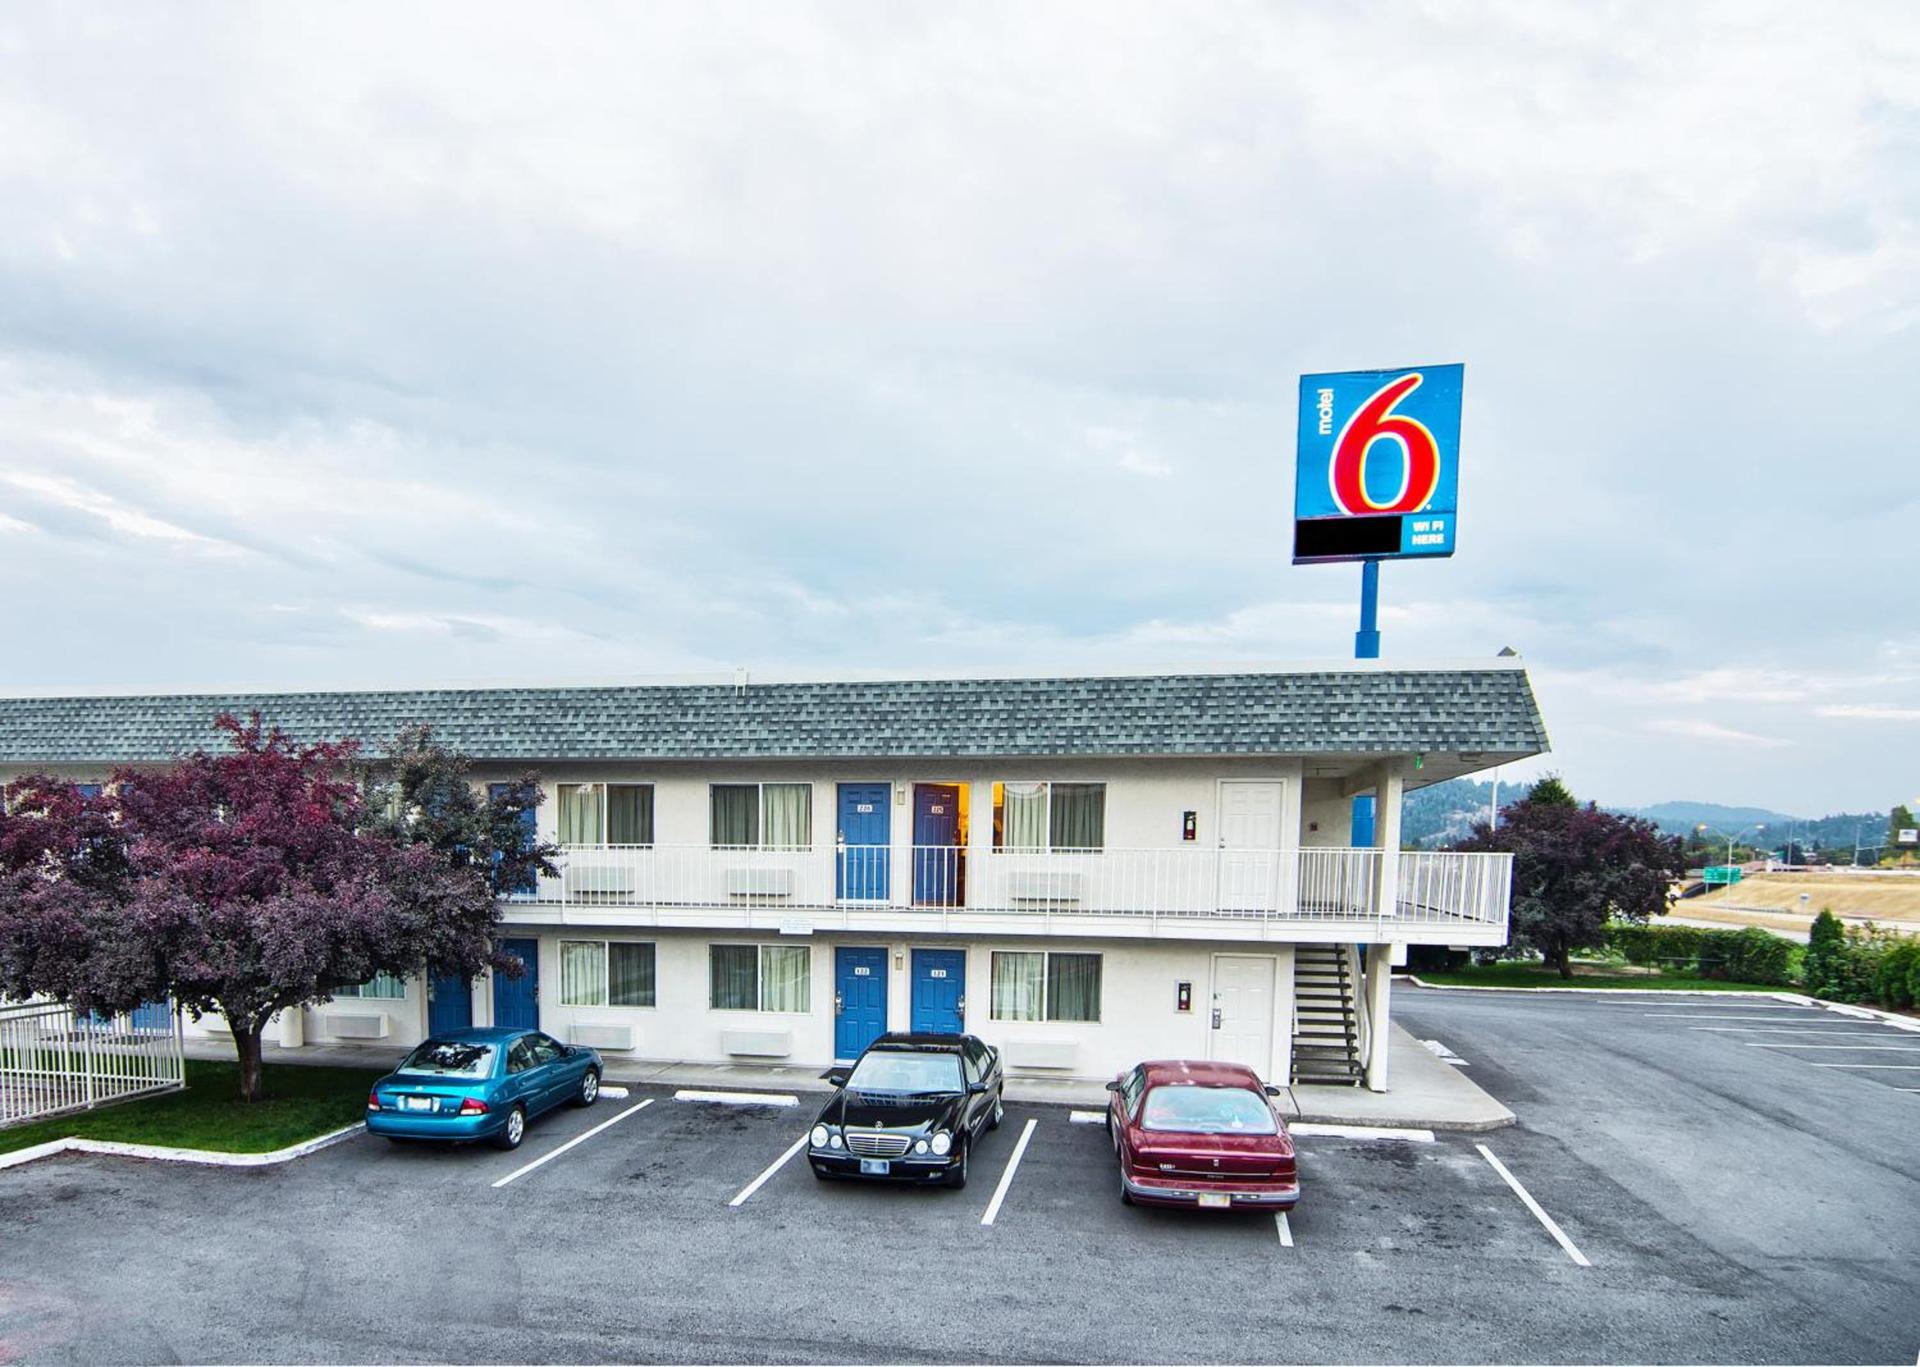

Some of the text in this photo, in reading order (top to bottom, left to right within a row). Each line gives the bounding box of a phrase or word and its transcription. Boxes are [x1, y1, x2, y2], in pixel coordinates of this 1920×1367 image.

[1316, 372, 1441, 516] motel 6
[1411, 533, 1445, 545] HERE
